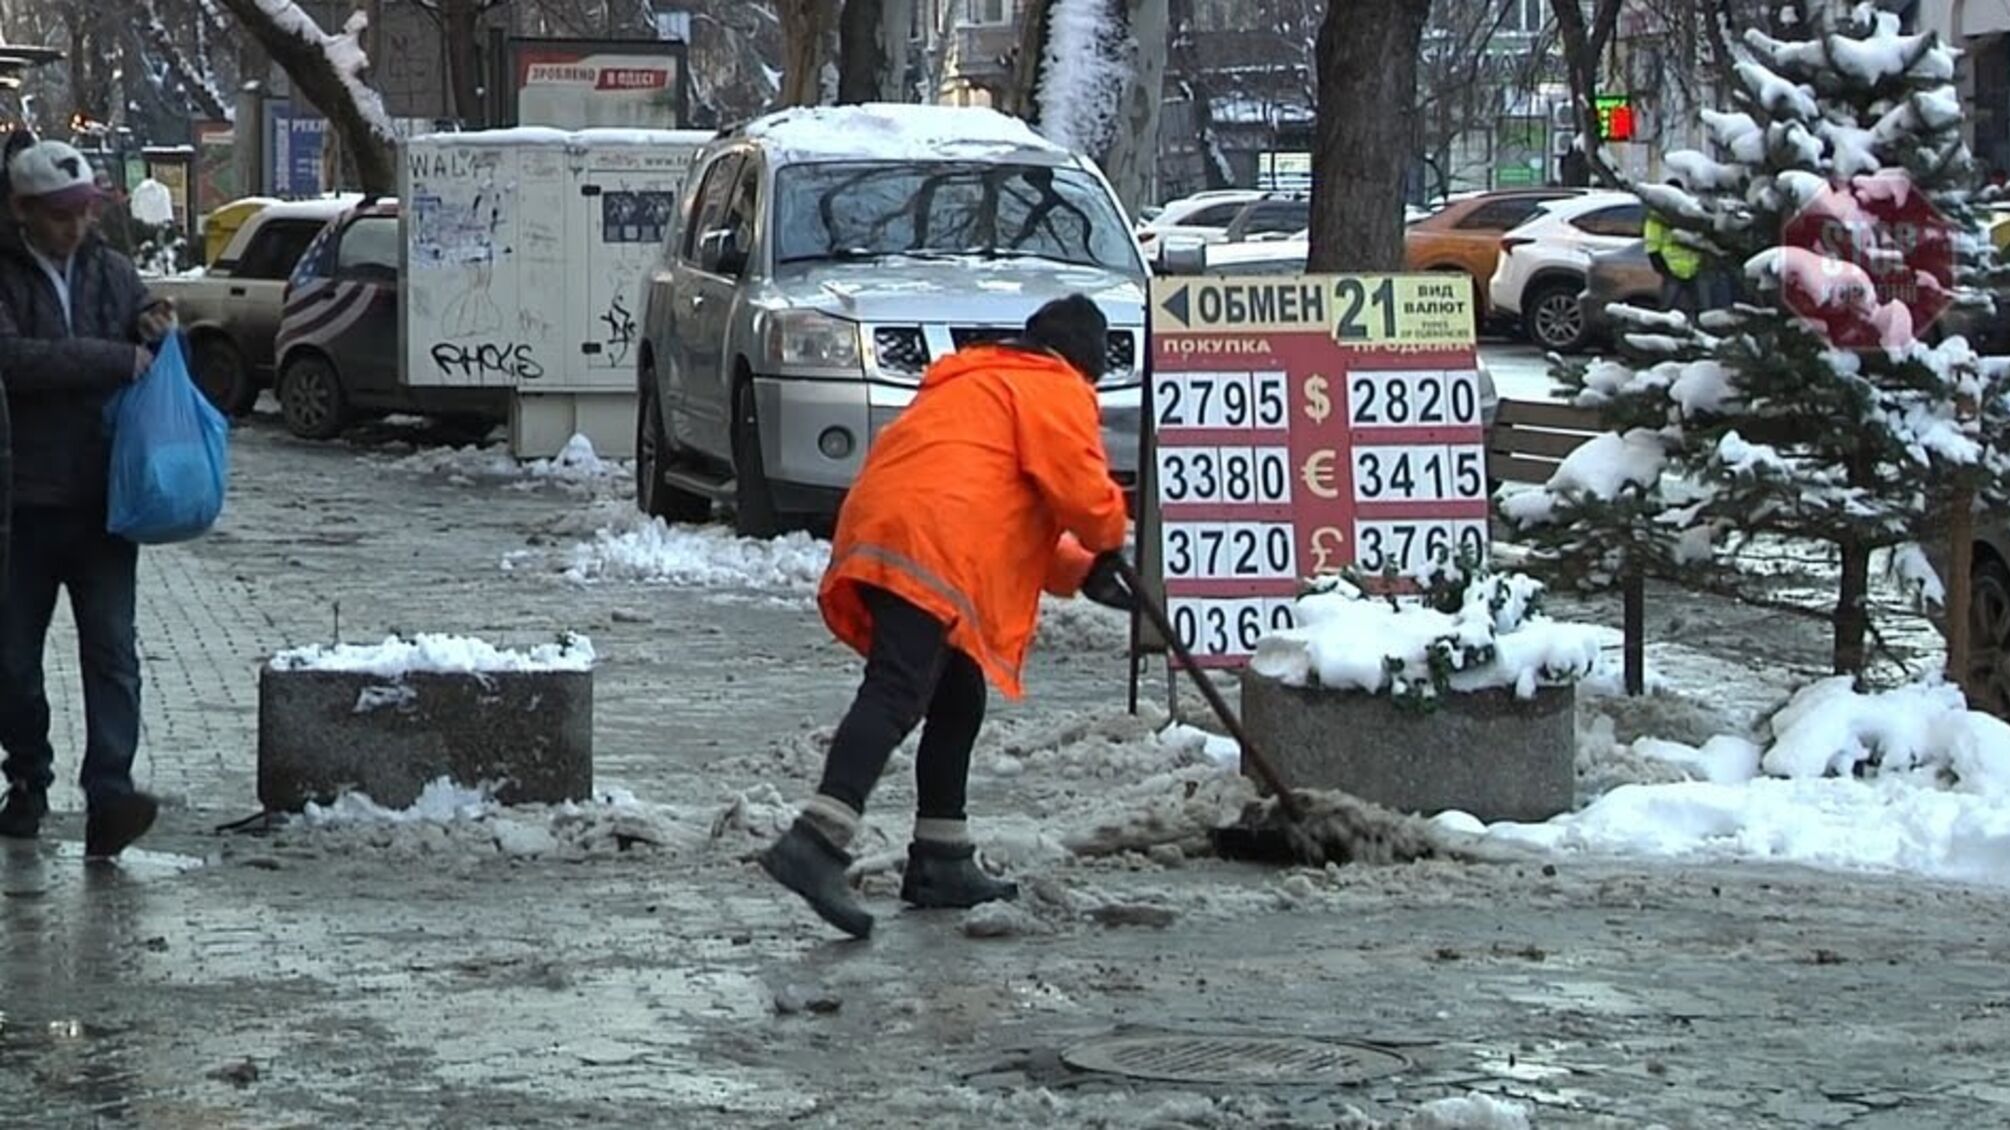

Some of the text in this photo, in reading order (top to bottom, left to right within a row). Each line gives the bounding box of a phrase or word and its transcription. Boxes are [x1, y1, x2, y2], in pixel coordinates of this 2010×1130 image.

[1199, 284, 1324, 326] ОБМЕН
[1335, 278, 1396, 339] 21
[1404, 302, 1465, 315] ВАЛЮТ
[1418, 285, 1454, 298] ВИД
[1163, 338, 1272, 354] ПОКУПКА
[1158, 379, 1284, 426] 2795
[1353, 377, 1476, 424] 2820
[1163, 453, 1286, 501] 3380
[1358, 451, 1482, 499] 3415
[1168, 526, 1290, 575] 3720
[1360, 525, 1484, 573] 3760
